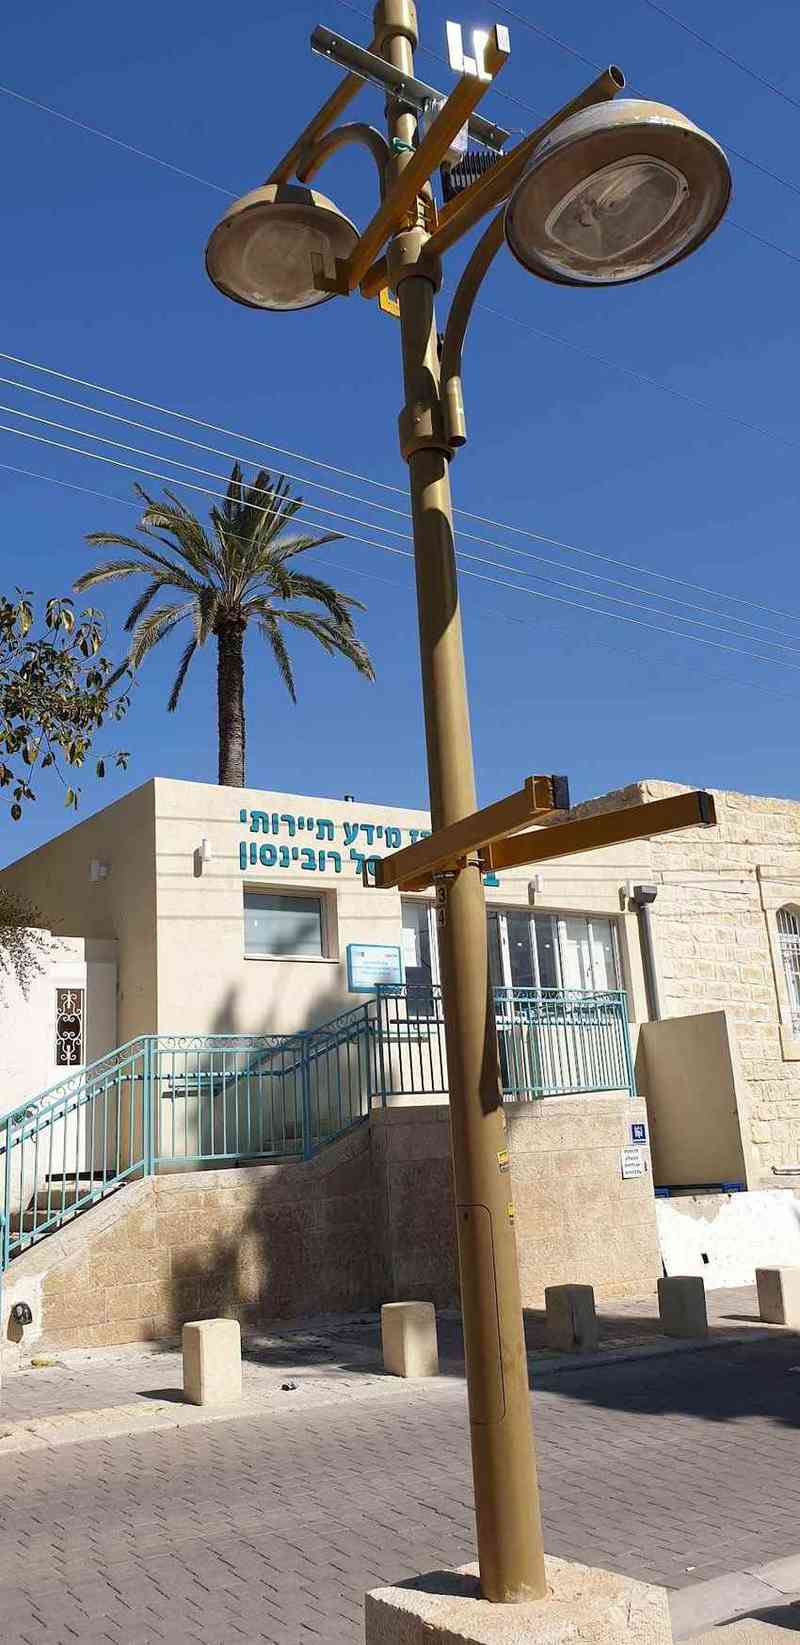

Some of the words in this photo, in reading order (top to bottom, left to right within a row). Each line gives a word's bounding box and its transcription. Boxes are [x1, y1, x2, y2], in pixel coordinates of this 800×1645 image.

[240, 809, 335, 841] תיירותי
[343, 822, 401, 848] מידע
[240, 841, 342, 873] רובינסון
